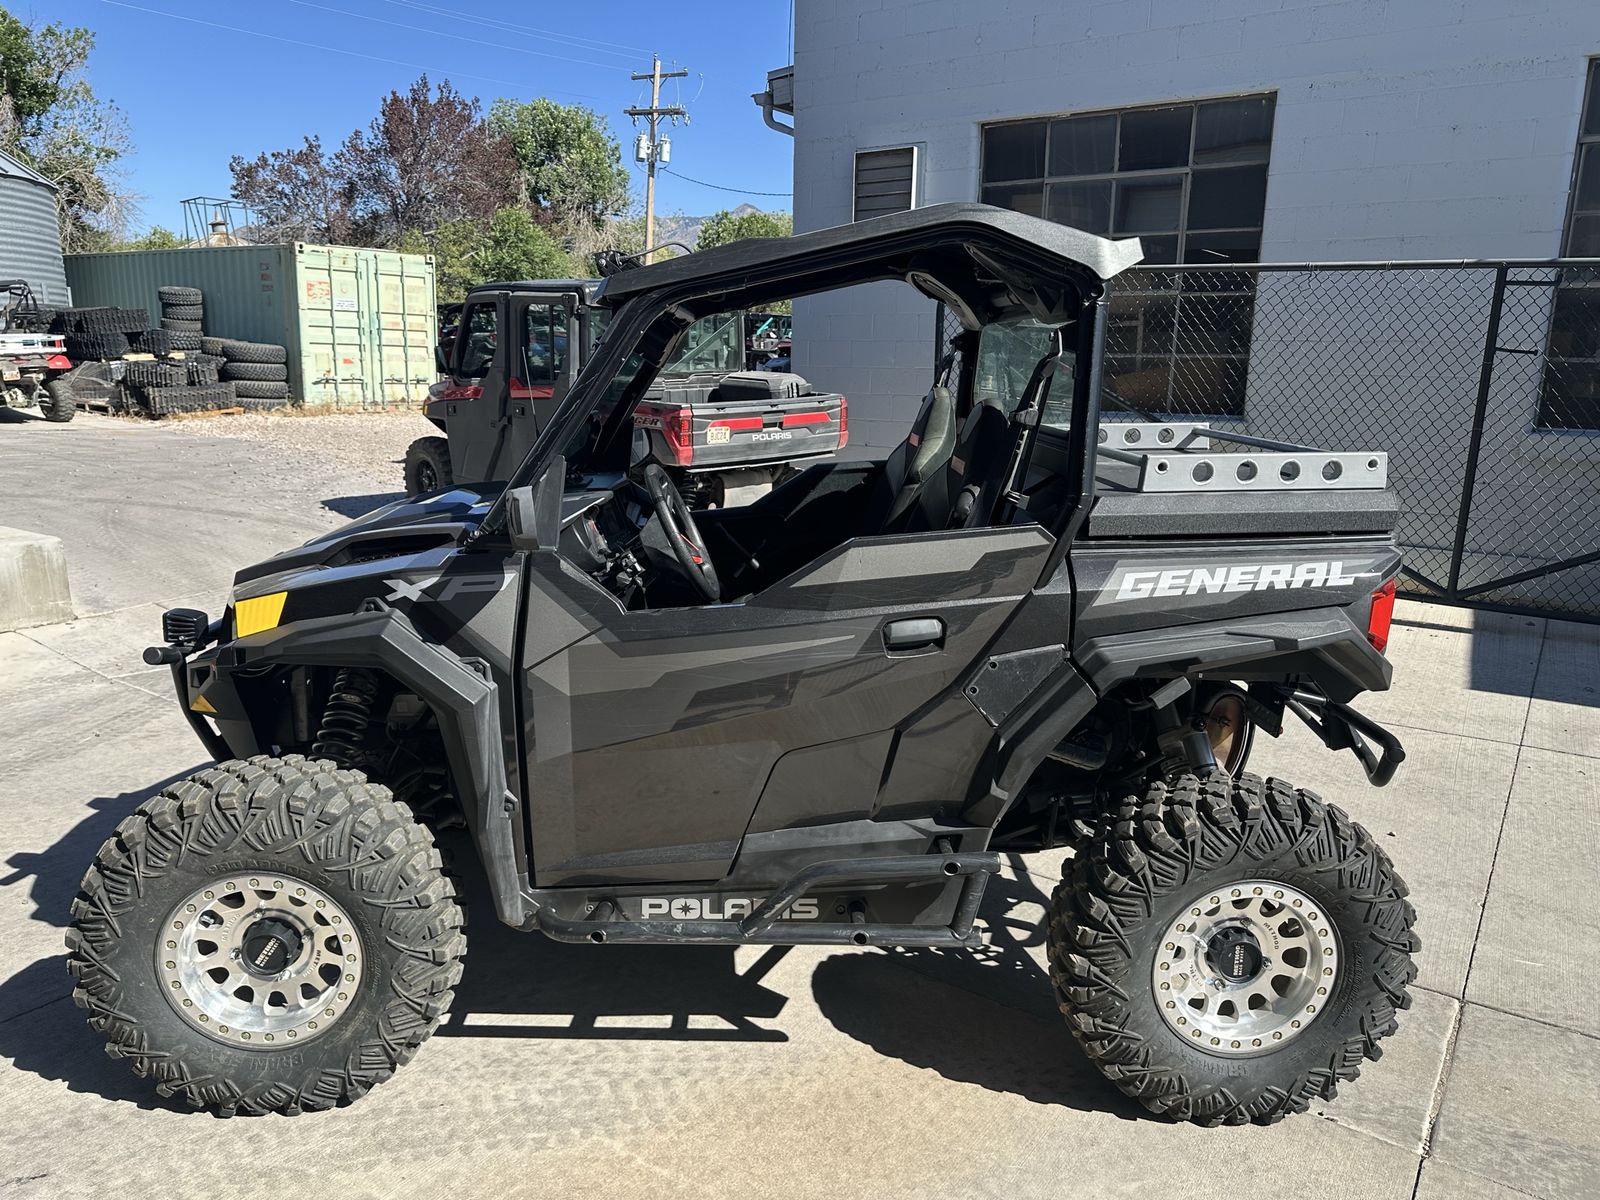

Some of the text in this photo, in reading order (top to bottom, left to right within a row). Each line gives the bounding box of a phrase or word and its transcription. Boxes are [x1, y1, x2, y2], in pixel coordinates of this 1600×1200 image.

[752, 431, 792, 442] POLARIS
[382, 572, 517, 602] XP
[1115, 561, 1355, 600] GENERAL
[641, 898, 819, 920] POLAS
[1263, 921, 1280, 950] METHOD
[255, 937, 277, 966] METHOD
[303, 949, 322, 978] METHOD
[1232, 945, 1241, 976] METHOD
